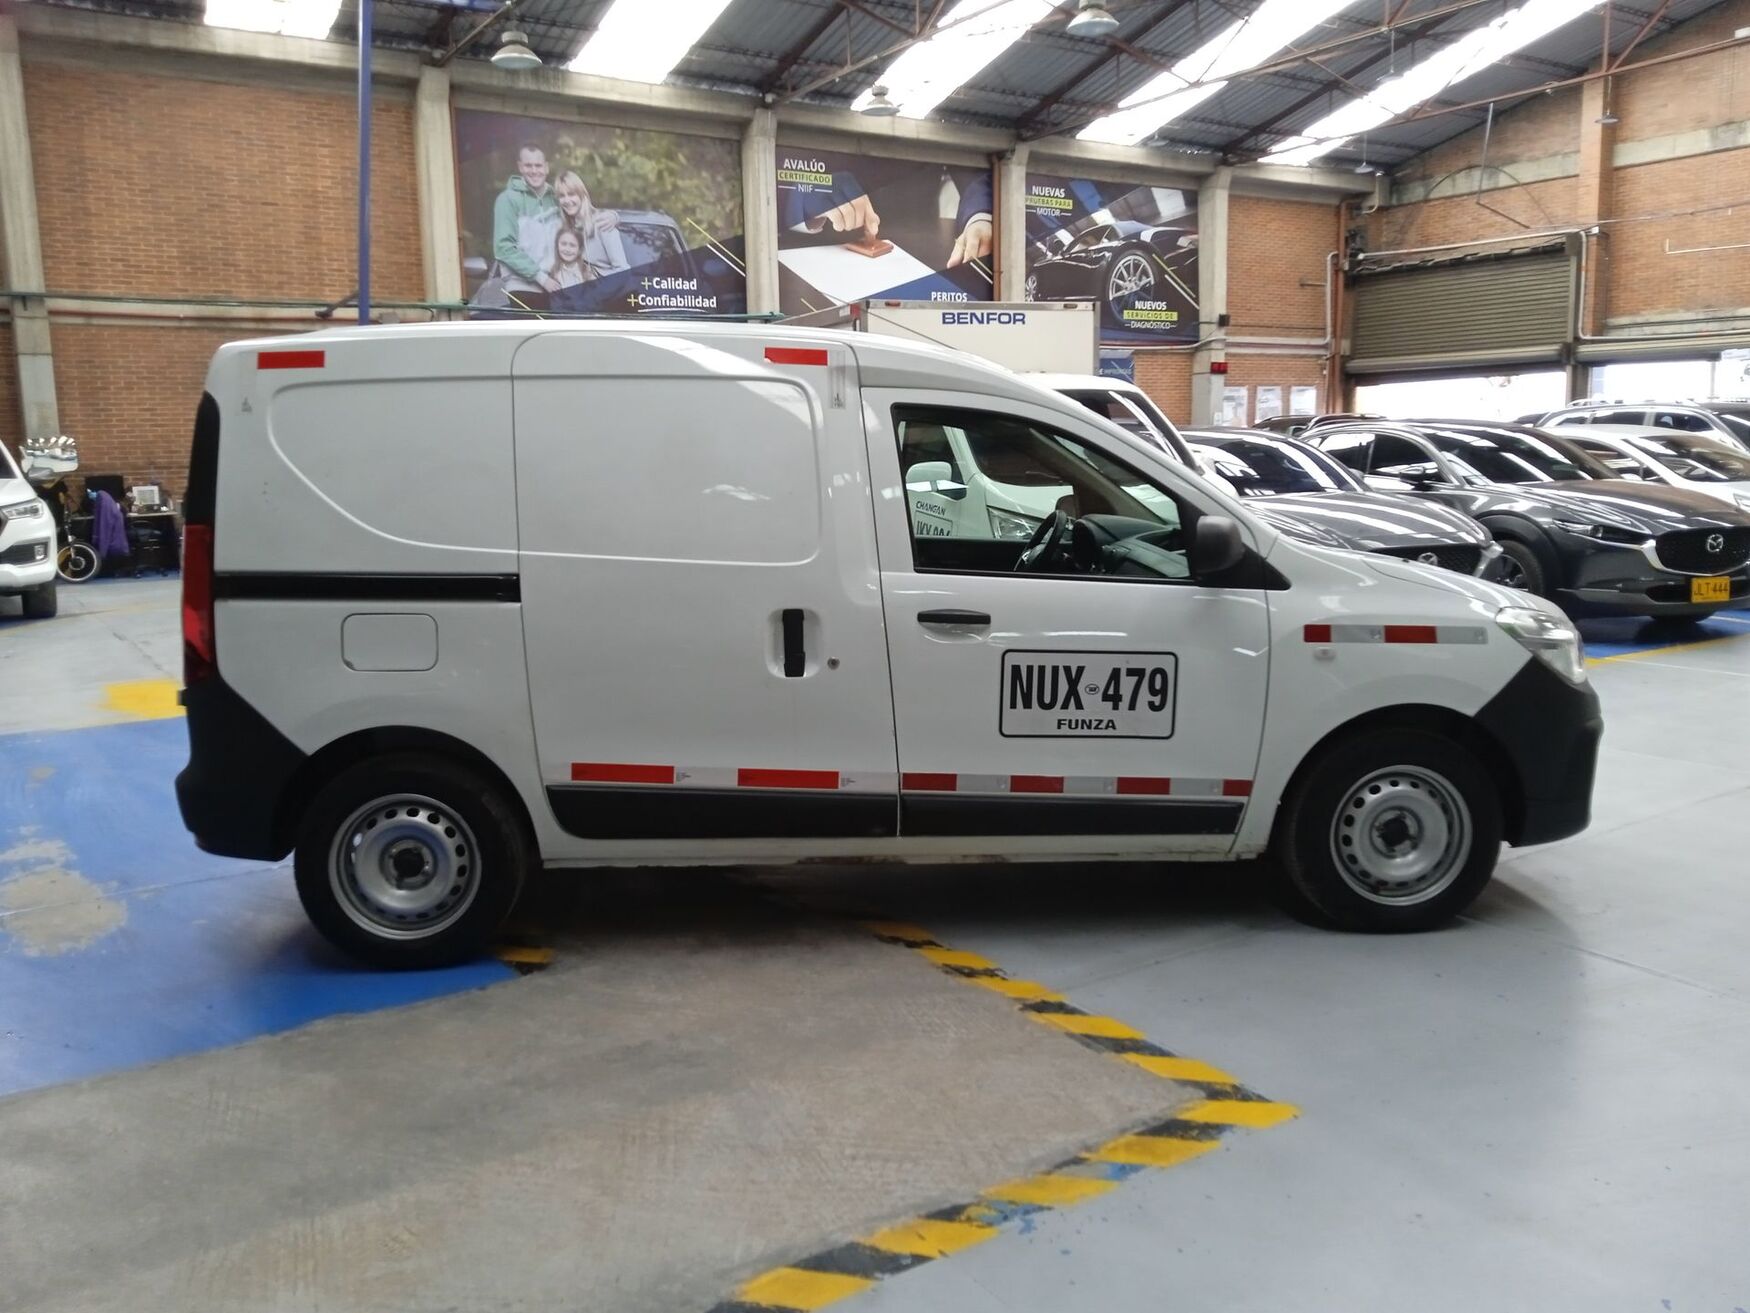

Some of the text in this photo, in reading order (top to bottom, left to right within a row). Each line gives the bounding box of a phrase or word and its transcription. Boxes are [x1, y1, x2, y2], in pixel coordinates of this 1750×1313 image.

[783, 158, 826, 173] AVALÚO
[779, 171, 831, 183] CERTIFICADO
[1032, 185, 1066, 198] NUEVAS
[1036, 207, 1061, 217] MOTOR
[931, 291, 968, 302] PERITOS
[1135, 301, 1167, 310] NUEVOS
[942, 312, 1026, 325] BENFOR
[1126, 311, 1162, 319] SERVICIOS
[916, 500, 946, 516] CHANGAN
[1009, 664, 1169, 712] NUX 479
[1057, 719, 1117, 730] FUNZA
